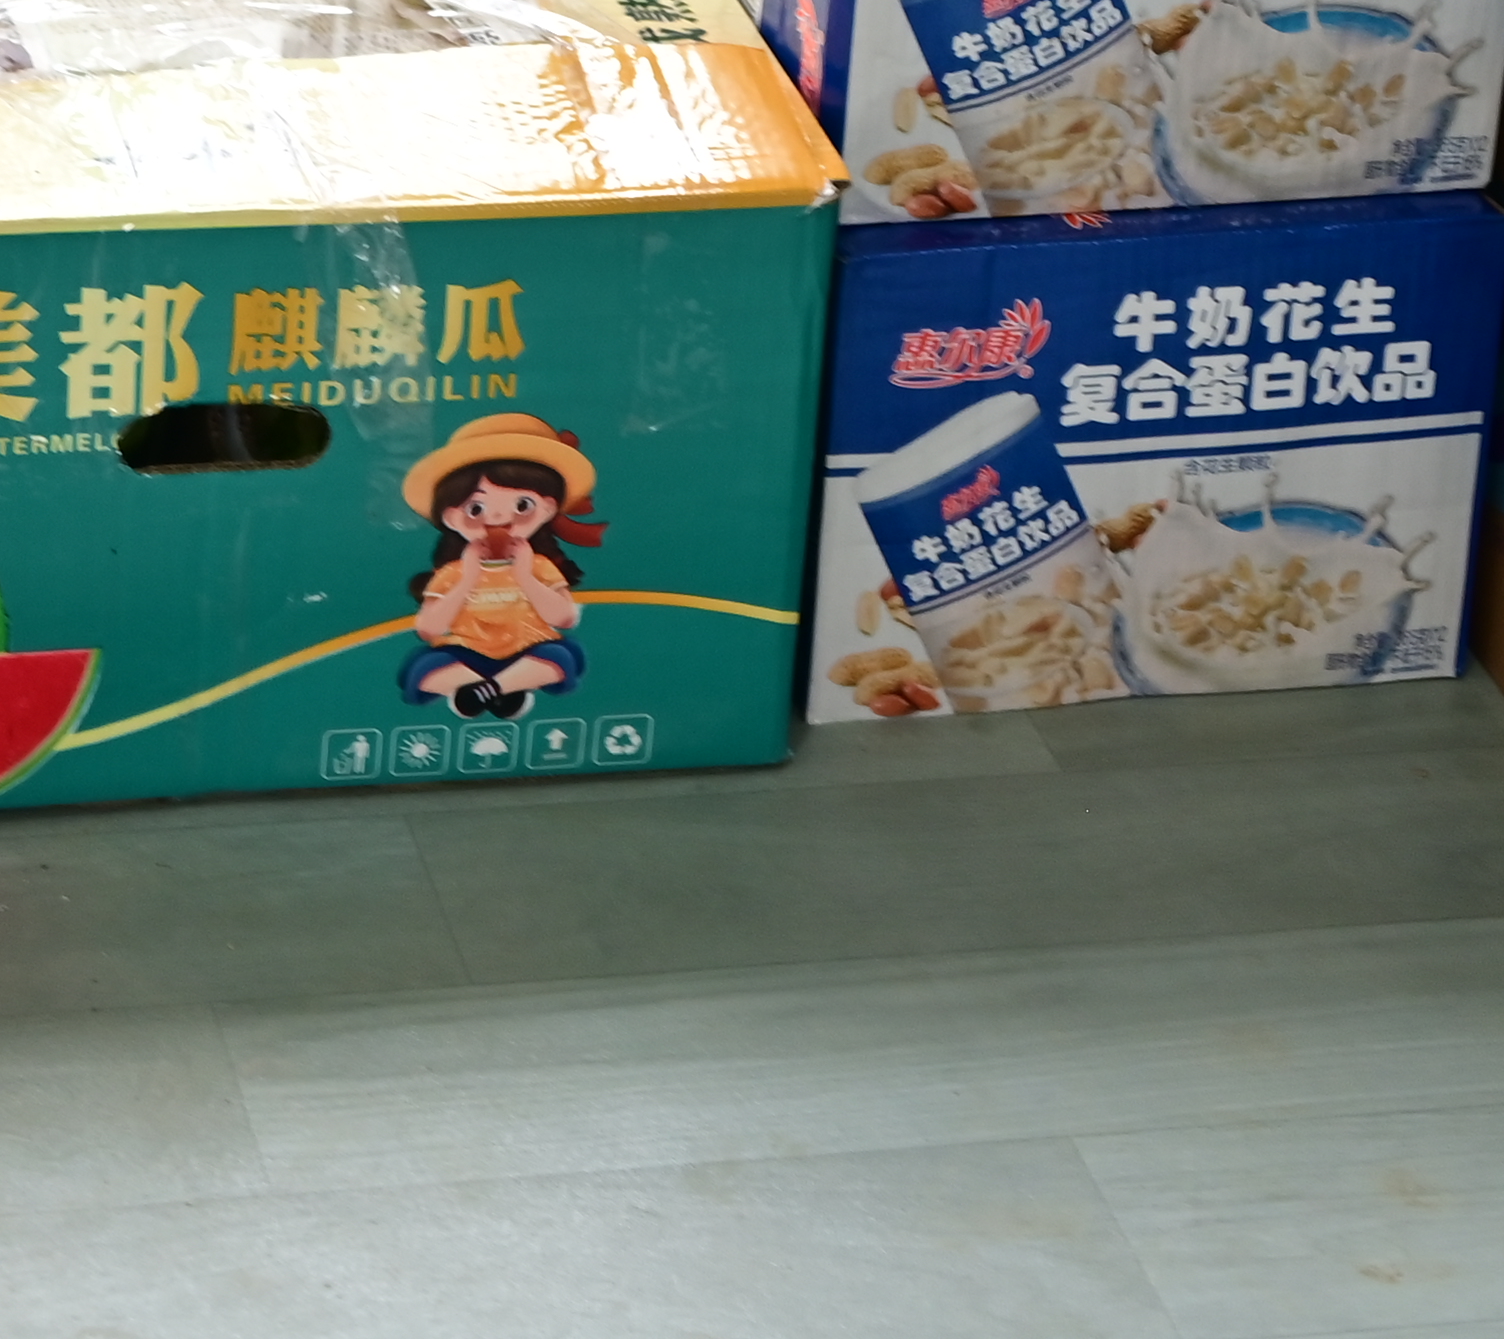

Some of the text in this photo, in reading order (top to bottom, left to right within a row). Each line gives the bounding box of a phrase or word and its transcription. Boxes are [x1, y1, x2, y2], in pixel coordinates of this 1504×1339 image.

[228, 278, 526, 376] 麒麟瓜
[1113, 278, 1396, 353] 牛奶花生
[1059, 342, 1435, 426] 复合蛋白饮品
[902, 499, 1081, 603] 复合蛋白饮品
[911, 484, 1048, 564] 牛奶花生
